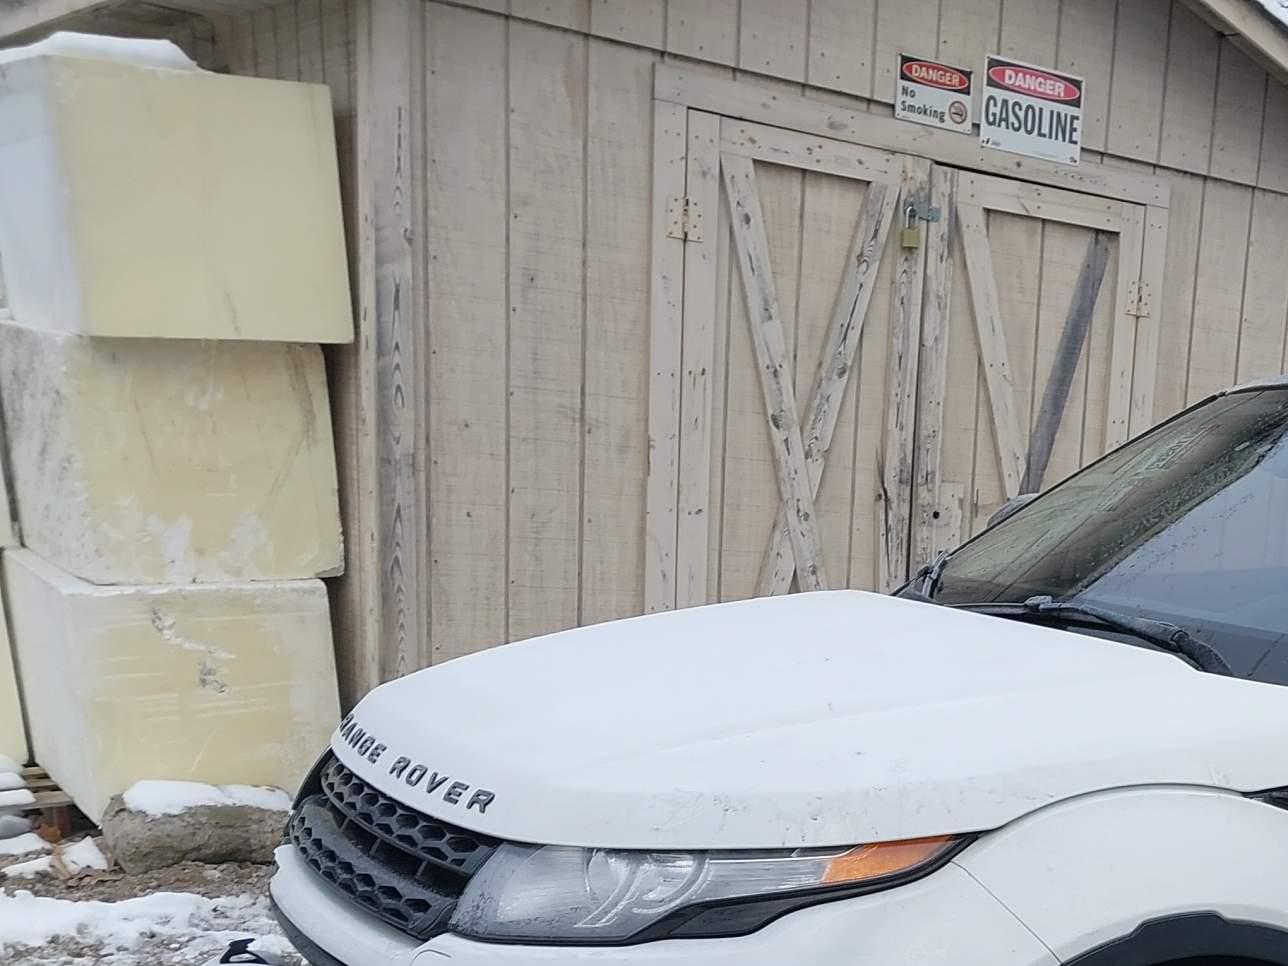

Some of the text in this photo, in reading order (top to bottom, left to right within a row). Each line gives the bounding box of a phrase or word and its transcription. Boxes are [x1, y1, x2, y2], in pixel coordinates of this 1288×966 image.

[911, 64, 960, 86] DANGER
[1004, 69, 1065, 97] DANGER
[901, 85, 916, 98] No
[901, 100, 946, 123] Smoking
[984, 95, 1080, 145] GASOLINE
[340, 713, 495, 814] RANGE ROVER
